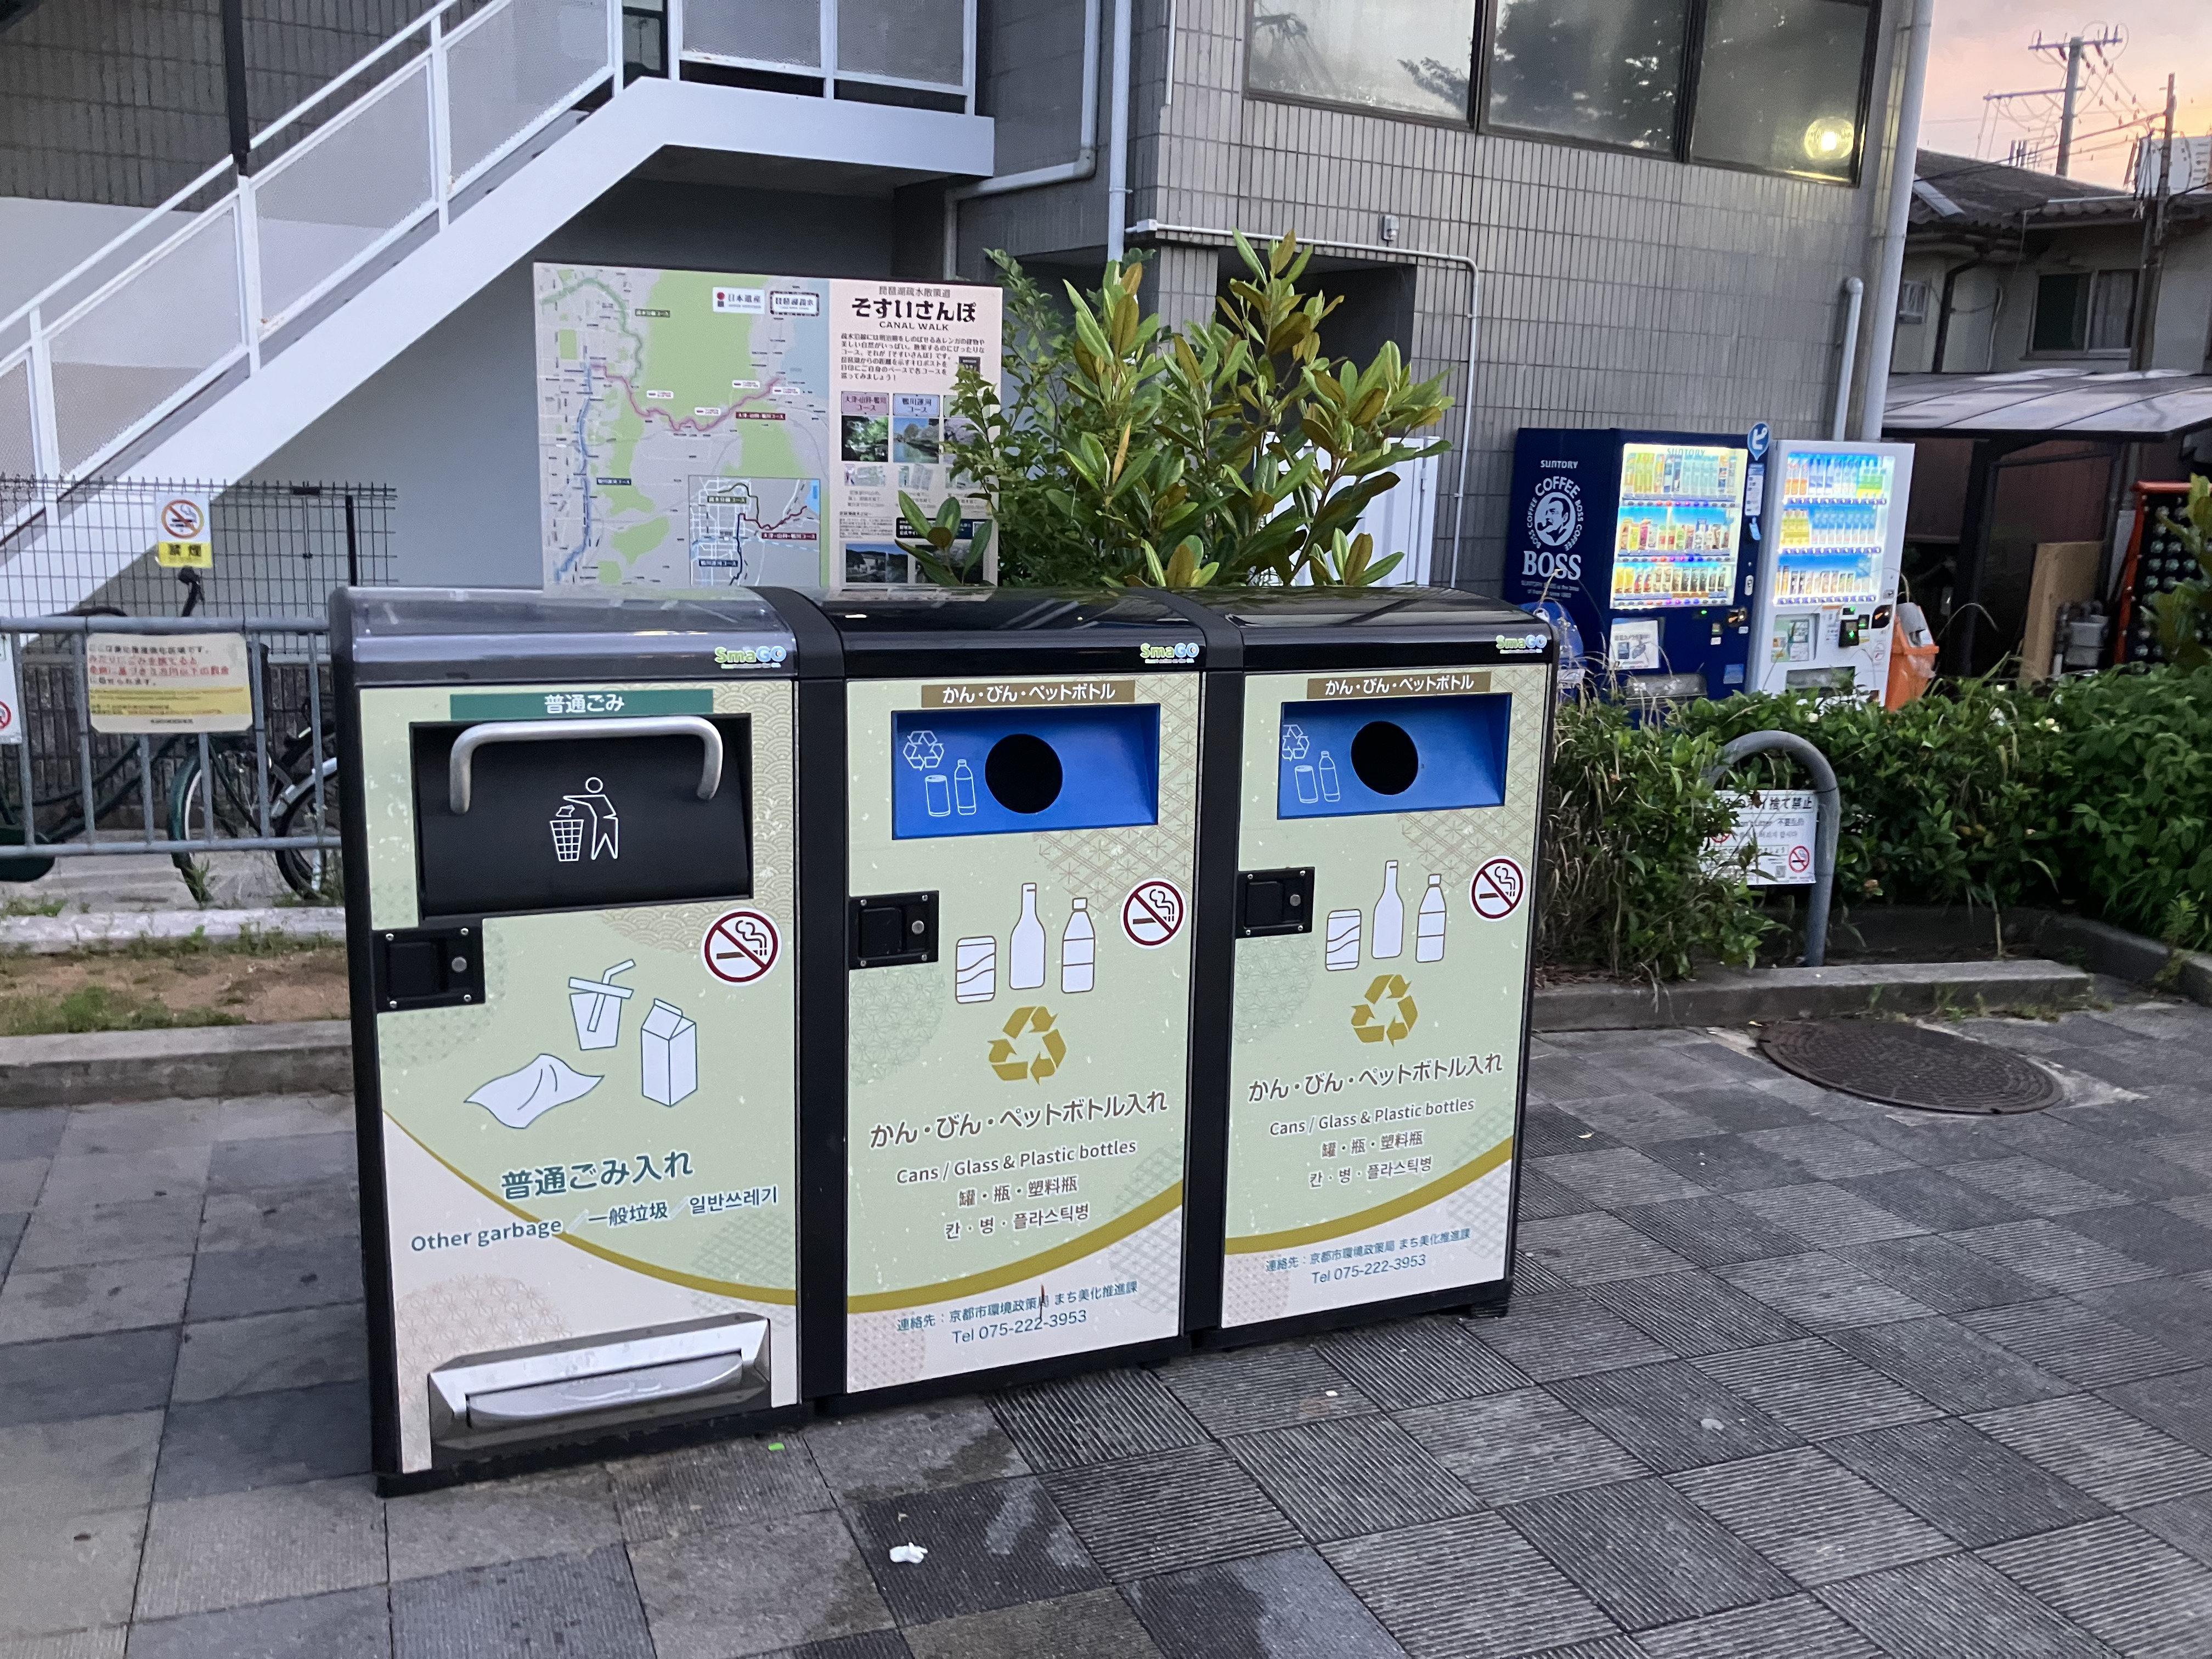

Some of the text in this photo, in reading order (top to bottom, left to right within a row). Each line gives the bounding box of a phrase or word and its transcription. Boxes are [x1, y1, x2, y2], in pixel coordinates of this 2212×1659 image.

[852, 297, 977, 323] そすいさんぽ
[879, 321, 949, 331] CANAL WALK
[1540, 460, 1578, 469] SUNTORY
[1535, 476, 1581, 499] COFFEE
[1522, 550, 1581, 580] BOSS
[714, 645, 787, 663] SmaGO
[1140, 642, 1199, 658] SmaGO
[1496, 634, 1547, 650] SmaGO
[943, 683, 1116, 703] かん・びん・ペットボトル
[1325, 674, 1474, 695] かん・びん・ペットボトル
[544, 694, 625, 714] 普通ごみ
[1248, 1053, 1503, 1102] かん・びん・ペットボトル入れ
[870, 1091, 1167, 1148] かん・びん・ペットボトル入れ
[1269, 1120, 1305, 1136] Cans
[1319, 1112, 1357, 1130] Glass
[1361, 1111, 1371, 1124] &
[1375, 1103, 1422, 1122] Plastic
[1426, 1099, 1475, 1115] bottles
[501, 1150, 694, 1200] 普通ごみ入れ
[896, 1166, 939, 1184] Cans
[954, 1156, 998, 1176] Glass
[1003, 1156, 1015, 1170] &
[1020, 1147, 1075, 1167] Plastic
[1080, 1140, 1136, 1159] bottles
[411, 1186, 778, 1252] Other garbage 一般垃圾 일반쓰레기
[1312, 1254, 1426, 1284] Tel 075-222-3953
[1054, 1280, 1138, 1306] まち美化推進課
[952, 1310, 1087, 1344] Tel 075-222-3953
